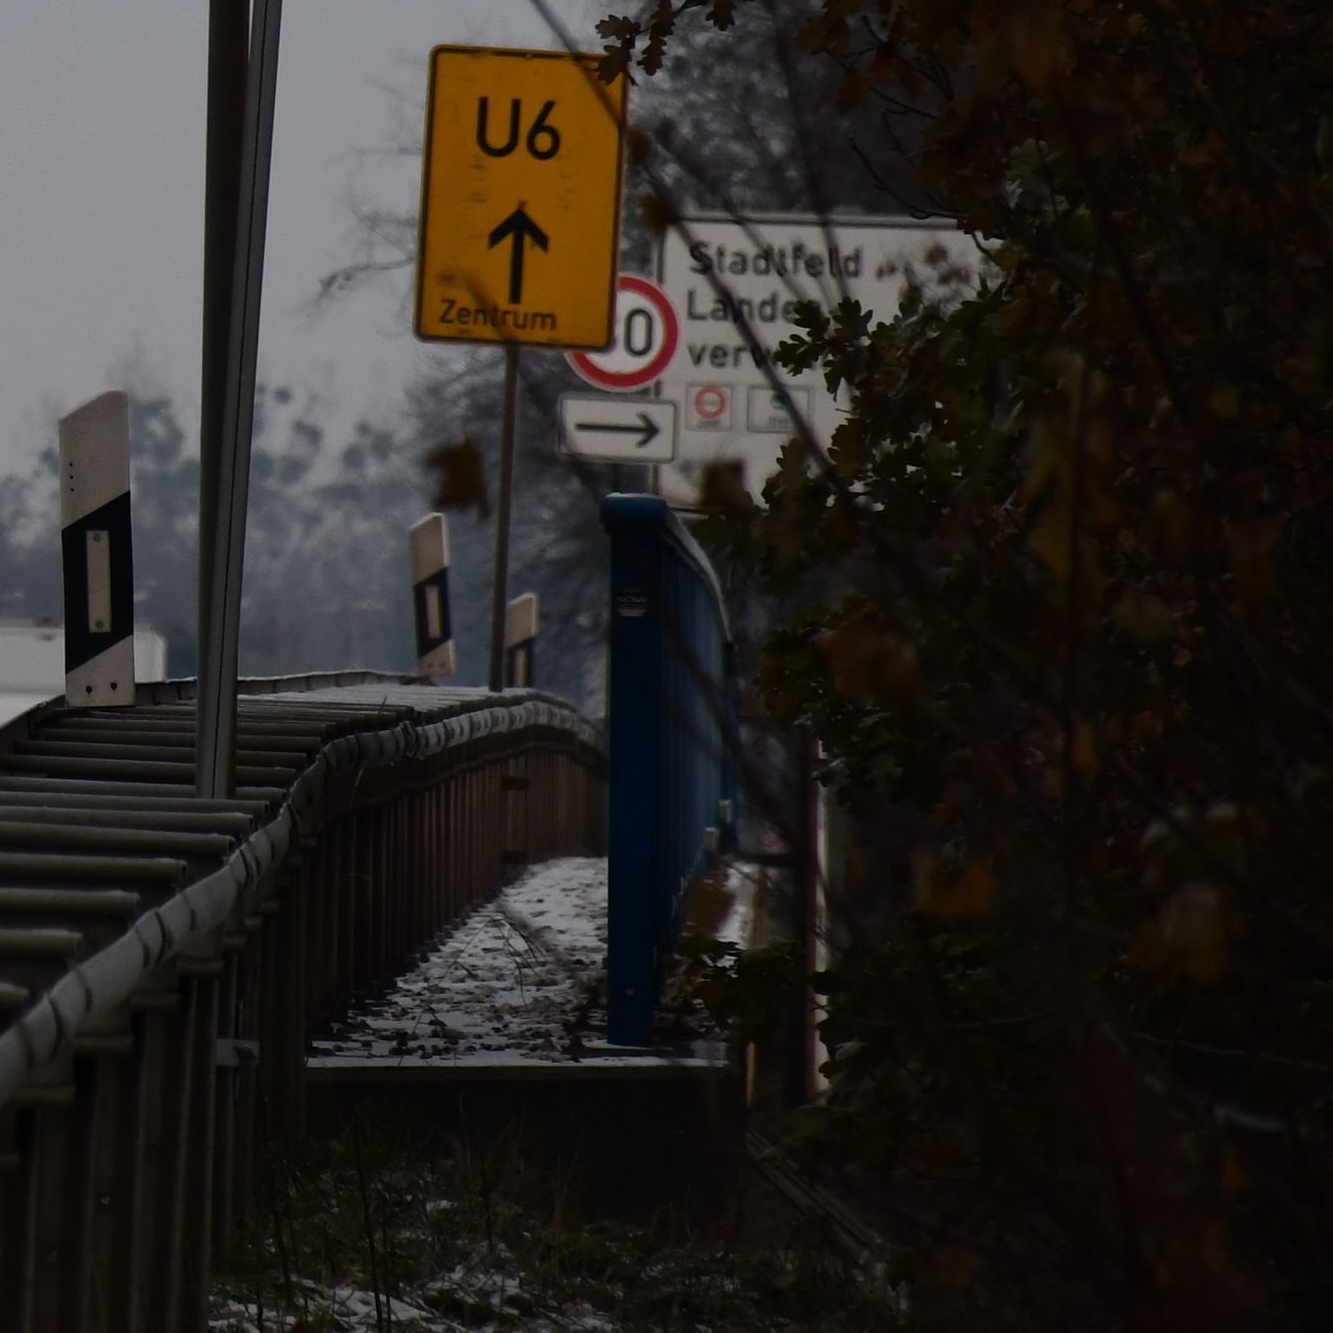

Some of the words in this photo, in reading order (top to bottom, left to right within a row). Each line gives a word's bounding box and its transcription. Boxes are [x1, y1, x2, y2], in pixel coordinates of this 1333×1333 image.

[475, 95, 562, 161] U6
[689, 242, 863, 279] Stadtfeld
[438, 299, 558, 332] Zentrum
[686, 290, 801, 323] Lande
[621, 308, 654, 357] 0
